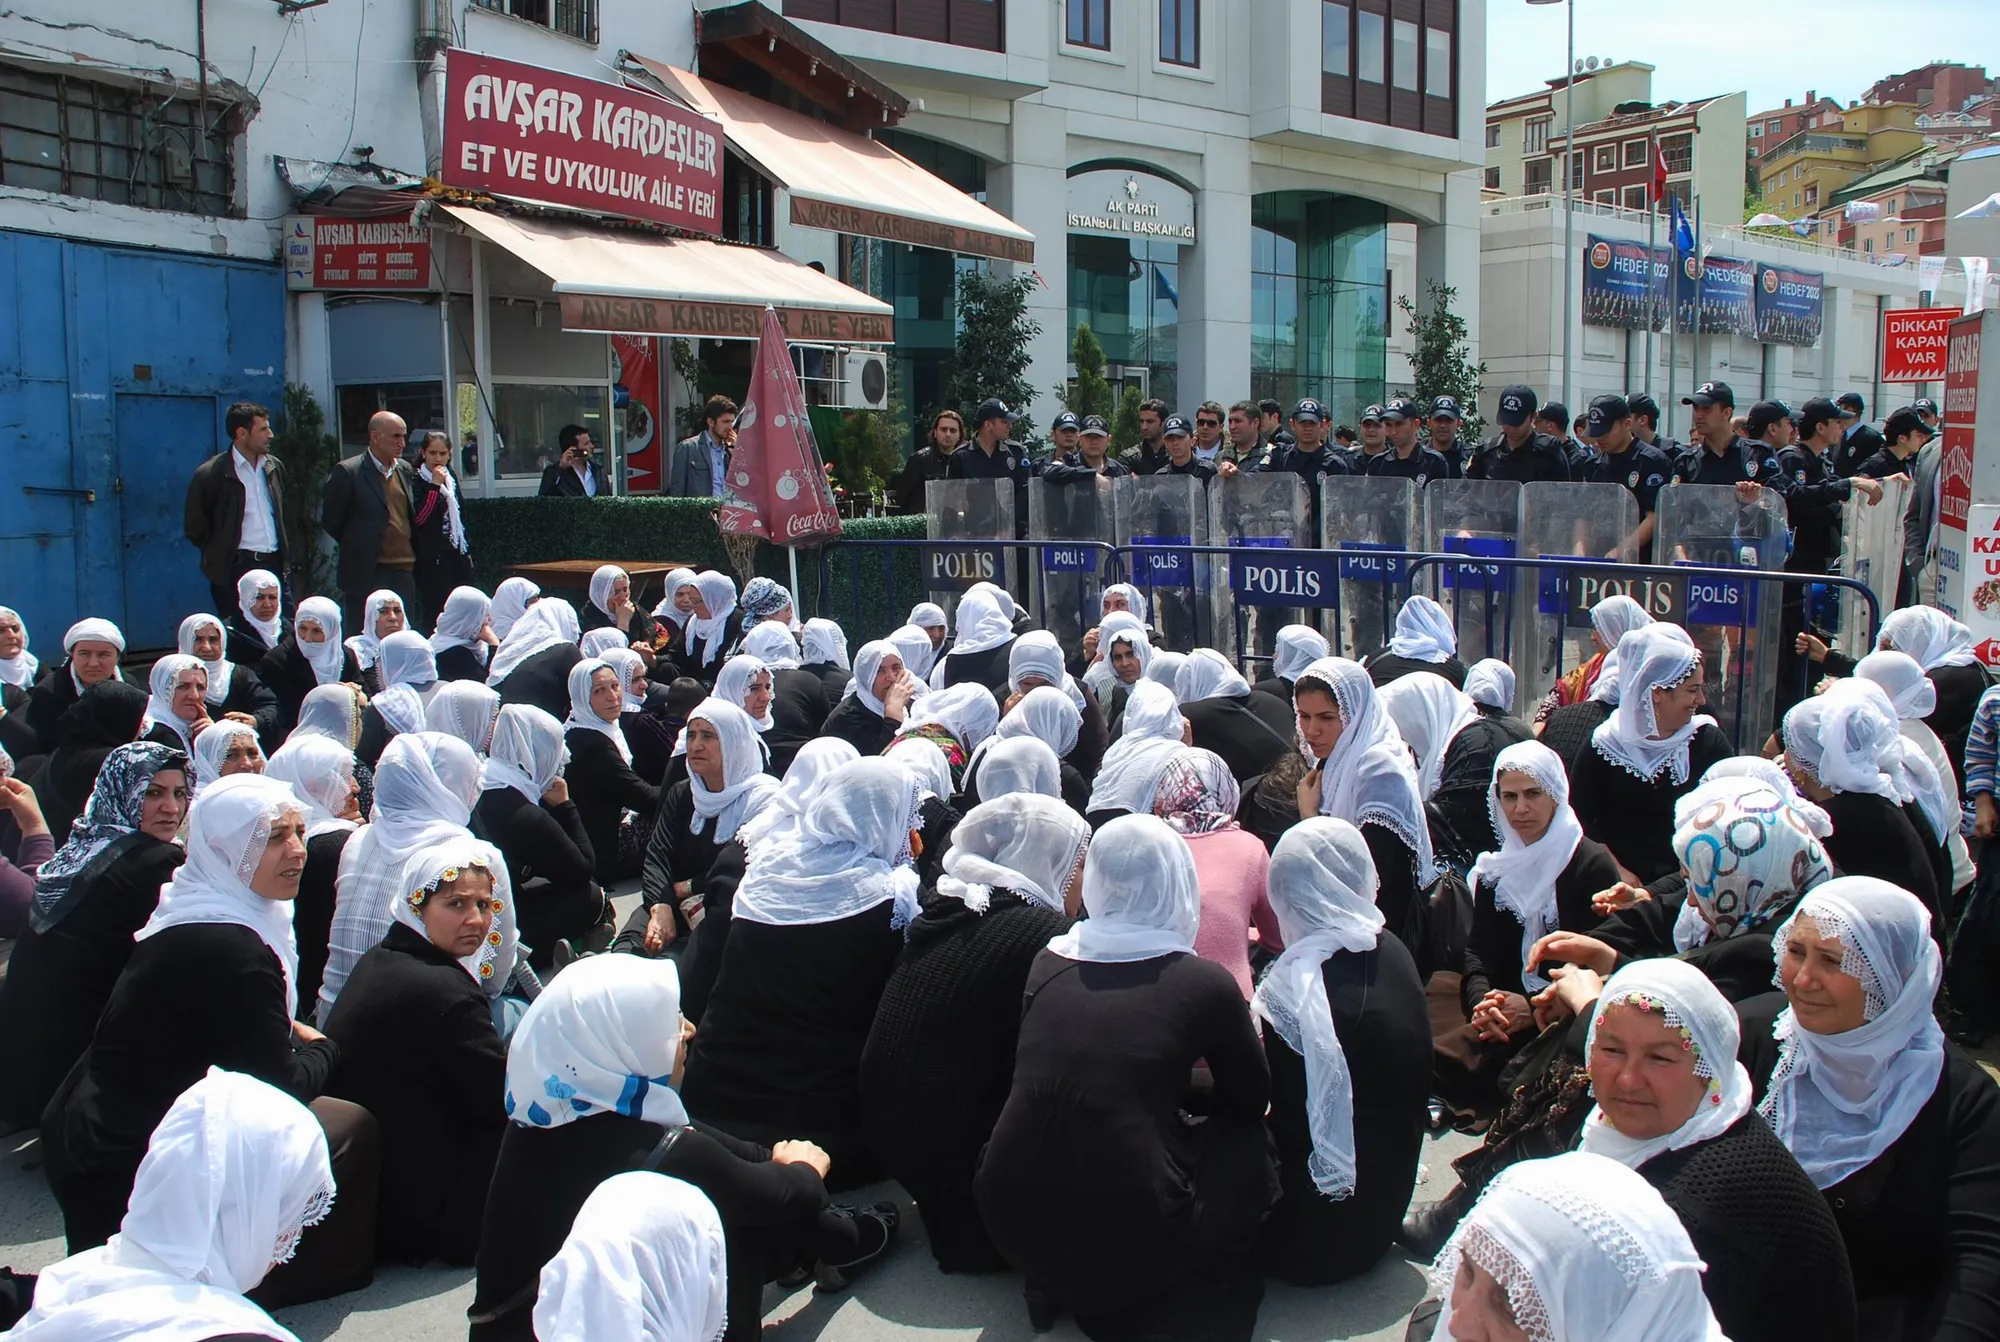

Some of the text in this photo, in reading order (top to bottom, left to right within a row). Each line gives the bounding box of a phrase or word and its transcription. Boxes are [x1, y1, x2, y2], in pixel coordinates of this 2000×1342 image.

[464, 74, 716, 178] AVŞAR KARDEŞLER
[461, 141, 716, 219] ET VE UYKULUK AİLE YERİ
[1107, 200, 1159, 217] AK PARTİ
[1067, 211, 1195, 238] İSTANBUL İL BAŞKANLIĞI
[317, 225, 354, 250] AVŞAR
[1614, 256, 1649, 275] HEDEF
[1653, 262, 1669, 279] 023
[801, 314, 839, 338] AİLE
[849, 316, 887, 340] YERİ
[1890, 318, 1946, 333] DİKKAT
[1896, 335, 1948, 349] KAPAN
[1905, 351, 1937, 364] VAR
[1948, 333, 1980, 383] AVŞAR
[932, 549, 994, 578] POLİS
[1349, 556, 1396, 571] POLS
[1243, 565, 1321, 598] POLİS
[1690, 584, 1739, 604] POLİS
